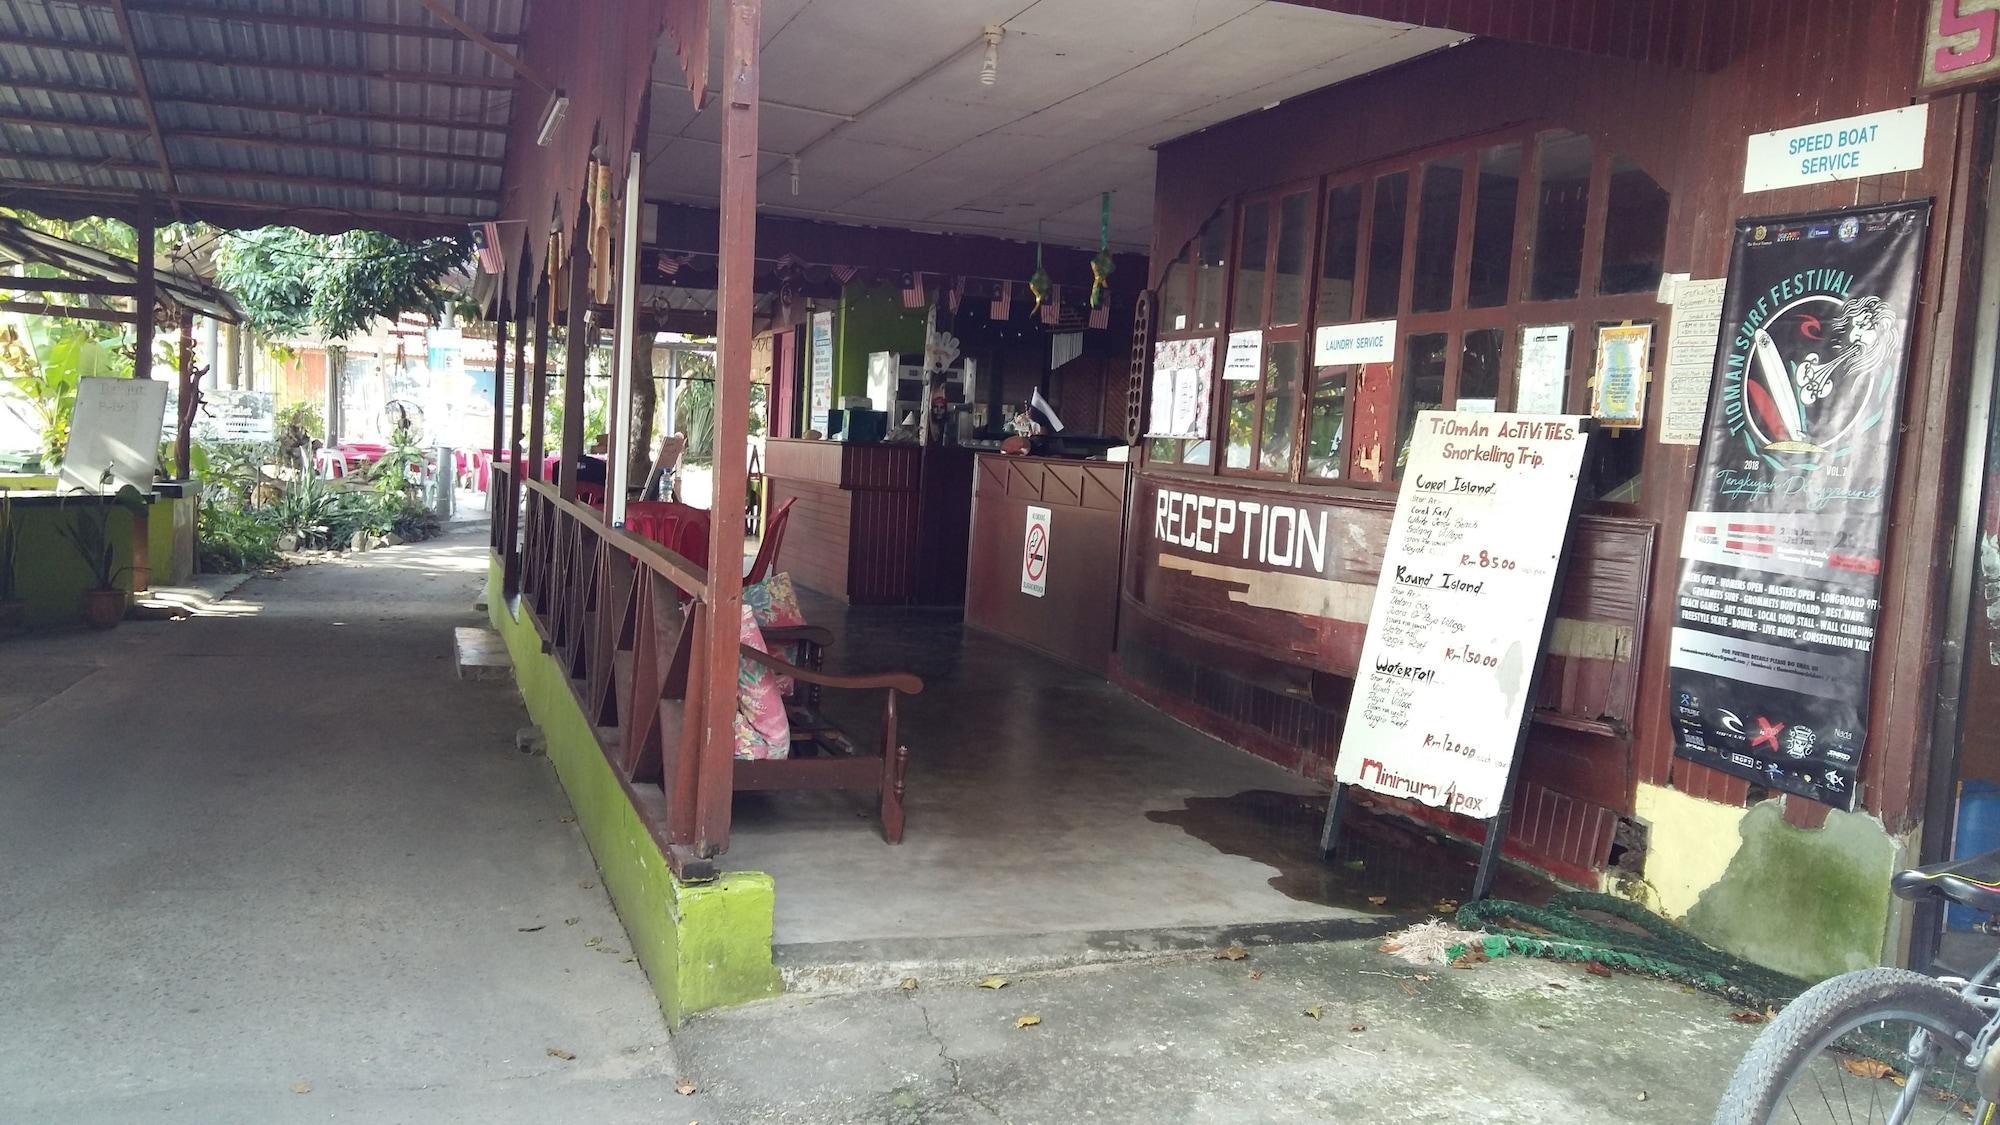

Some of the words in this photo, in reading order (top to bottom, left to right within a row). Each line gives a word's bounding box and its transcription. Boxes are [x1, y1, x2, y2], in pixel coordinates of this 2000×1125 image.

[1789, 133, 1833, 155] SPEED
[1838, 125, 1878, 147] BOAT
[1801, 151, 1860, 175] SERVICE
[1325, 338, 1354, 351] LAUNDRY
[1356, 335, 1384, 349] SERVICE
[1724, 353, 1746, 437] TIOMAN
[1735, 296, 1768, 350] SURF
[1770, 269, 1854, 306] FESTIVAL
[1442, 442, 1515, 469] Snorkelling
[1743, 460, 1760, 471] 2018
[1449, 475, 1497, 494] Island
[1155, 489, 1328, 573] RECEPTION
[1396, 565, 1434, 586] Round
[1439, 573, 1484, 595] Island
[1701, 575, 1717, 586] OPEN
[1720, 576, 1746, 591] WOMENS
[1747, 580, 1764, 594] OPEN
[1768, 584, 1799, 599] MASTERS
[1798, 589, 1816, 602] OPEN
[1821, 592, 1866, 608] LONGBOARD
[1866, 599, 1878, 610] 9FT
[1680, 597, 1699, 609] BEACH
[1700, 600, 1720, 612] GAMES
[1723, 604, 1736, 615] ART
[1736, 606, 1753, 618] STALL
[1758, 609, 1777, 622] LOCAL
[1778, 613, 1795, 625] FOOD
[1796, 615, 1815, 628] STALL
[1820, 619, 1839, 632] WALL
[1840, 623, 1874, 638] CLIMBING
[1692, 586, 1724, 600] GROMMETS
[1724, 591, 1740, 602] SURF
[1743, 594, 1779, 609] GROMMETS
[1780, 599, 1820, 616] BODYBOARD
[1843, 609, 1865, 621] WAVE
[1681, 610, 1710, 624] FREESTYLE
[1711, 614, 1728, 627] SKATE
[1732, 618, 1758, 632] BONFIRE
[1762, 623, 1776, 636] LIVE
[1776, 626, 1797, 639] MUSIC
[1802, 630, 1854, 649] CONSERVATION
[1854, 638, 1871, 652] TALK
